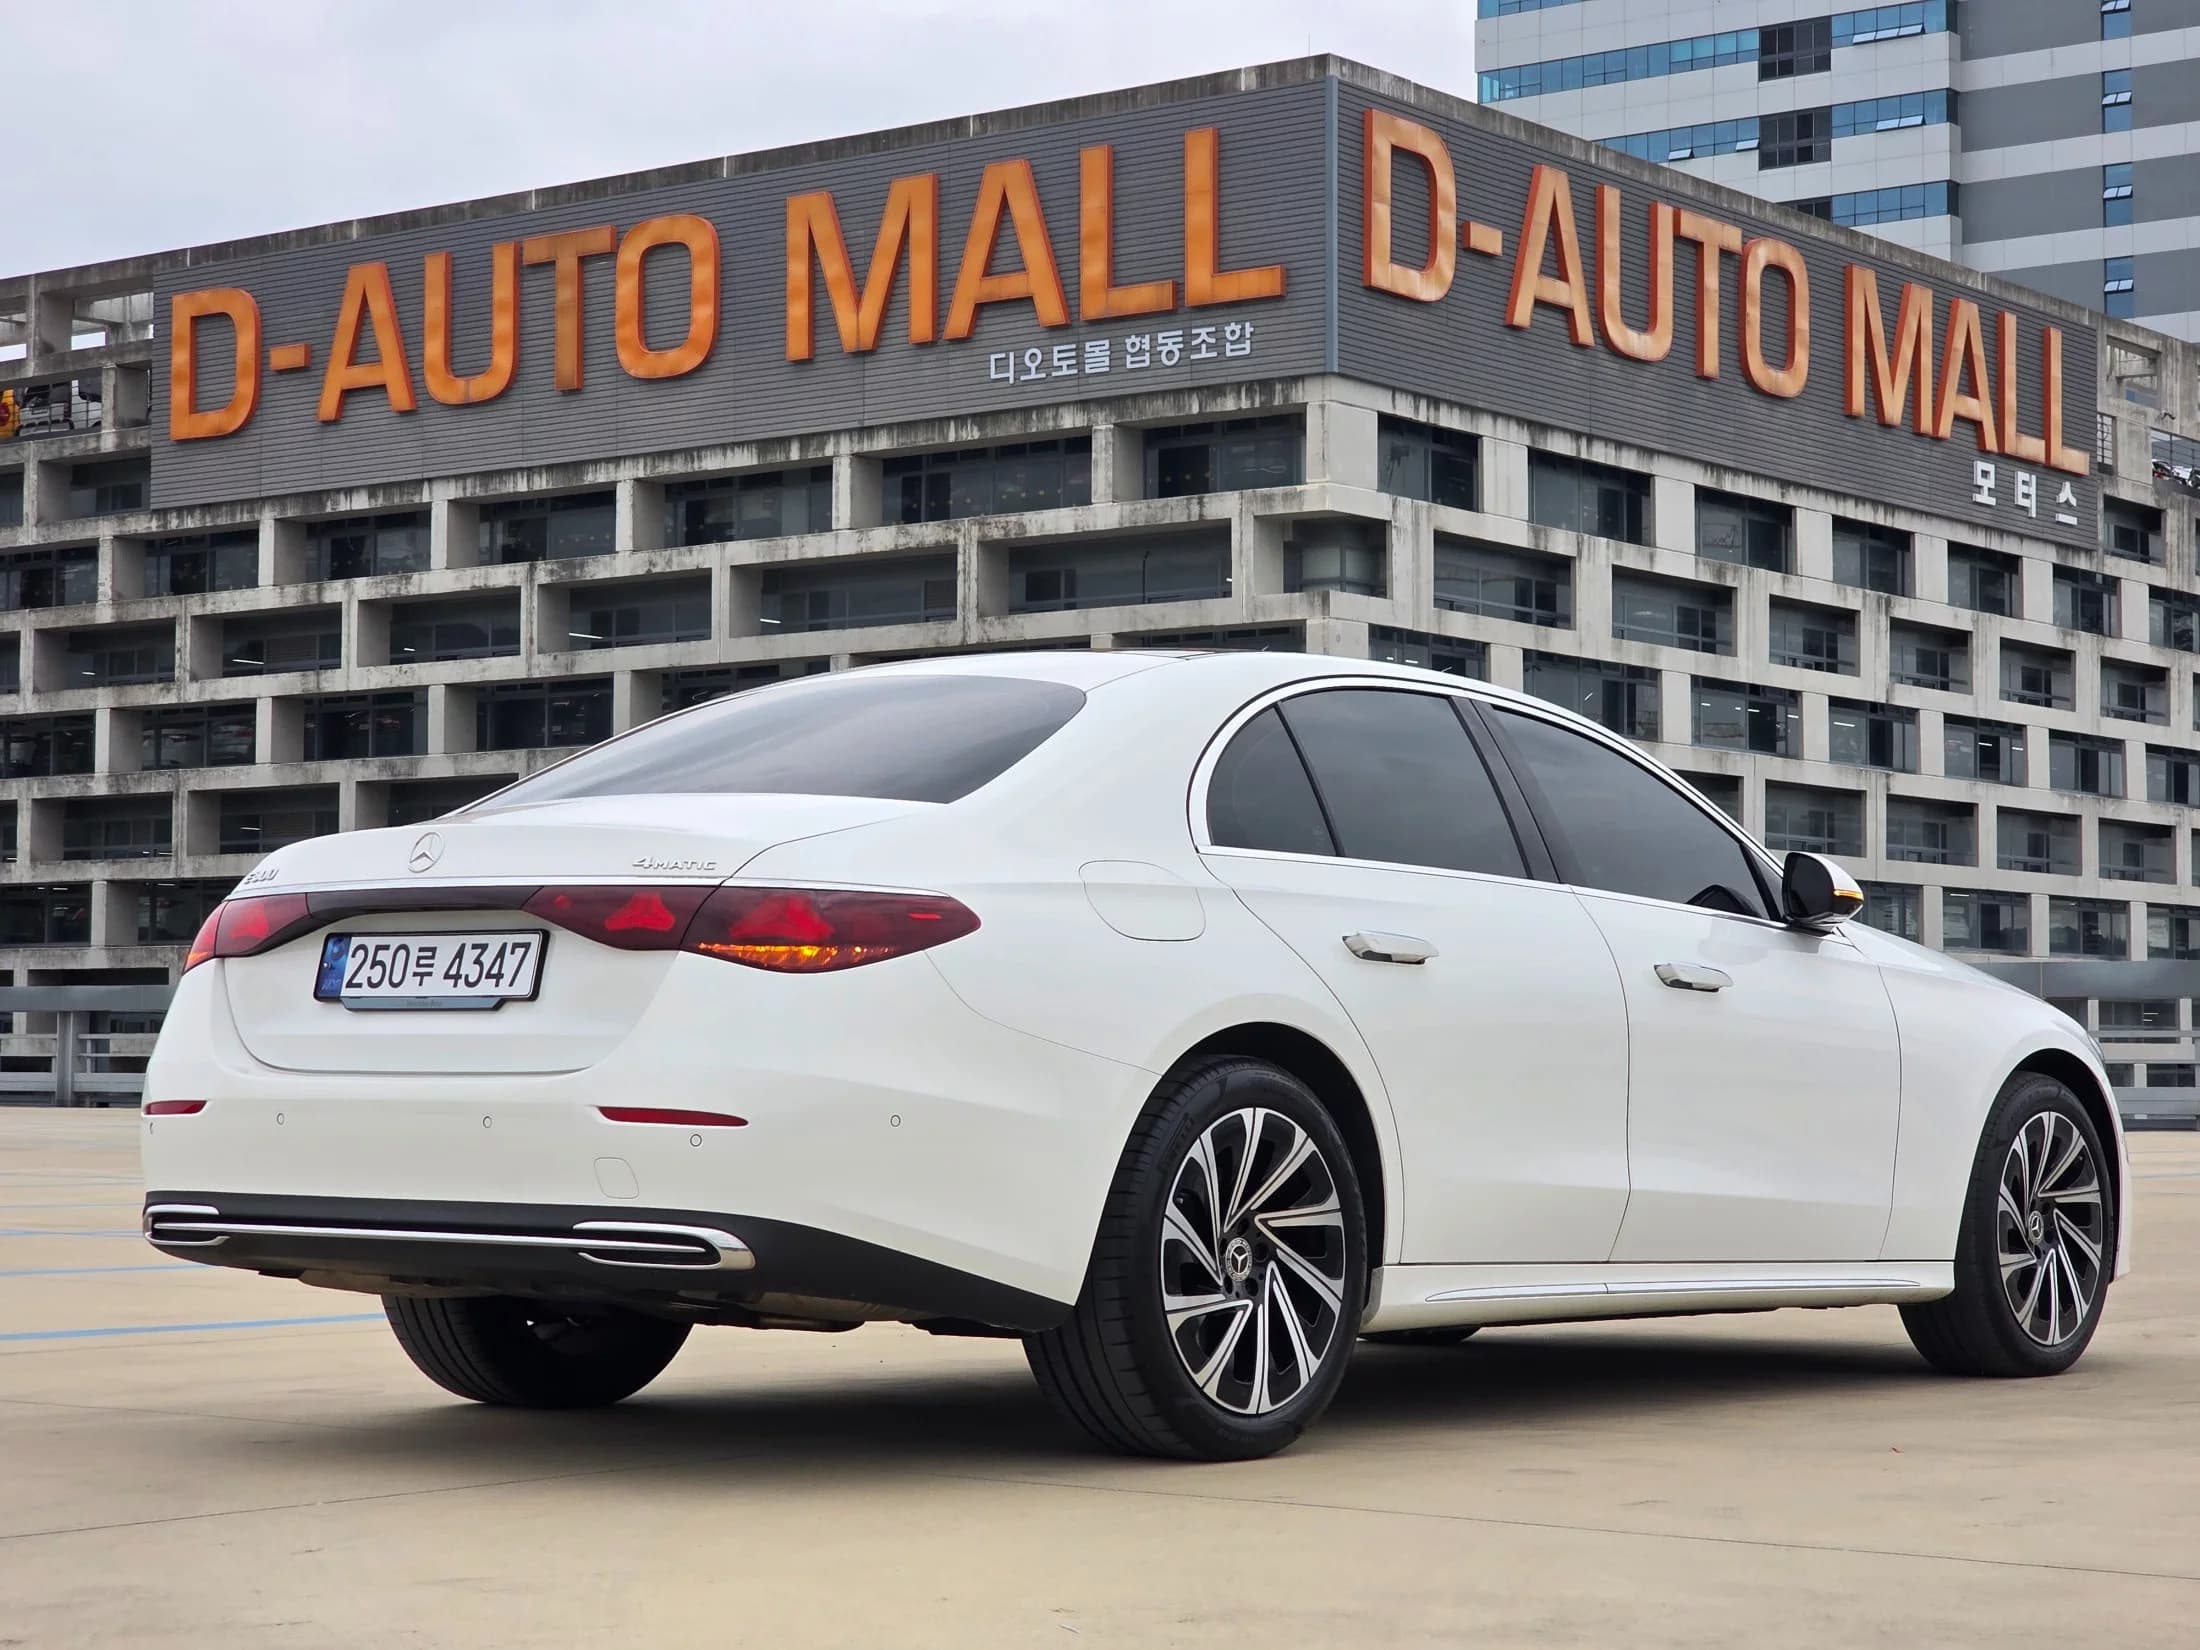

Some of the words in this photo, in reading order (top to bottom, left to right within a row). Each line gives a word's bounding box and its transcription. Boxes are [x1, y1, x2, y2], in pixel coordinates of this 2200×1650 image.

[169, 213, 722, 442] D-AUTO
[785, 127, 1287, 362] MALL
[1362, 108, 1811, 399] D-AUTO
[1843, 263, 2090, 476] MALL
[989, 338, 1112, 385] 디오토몰
[1124, 321, 1255, 369] 협동조합
[1972, 460, 2078, 526] 모터스
[632, 856, 717, 871] 4MATIC
[443, 941, 532, 988] 4347
